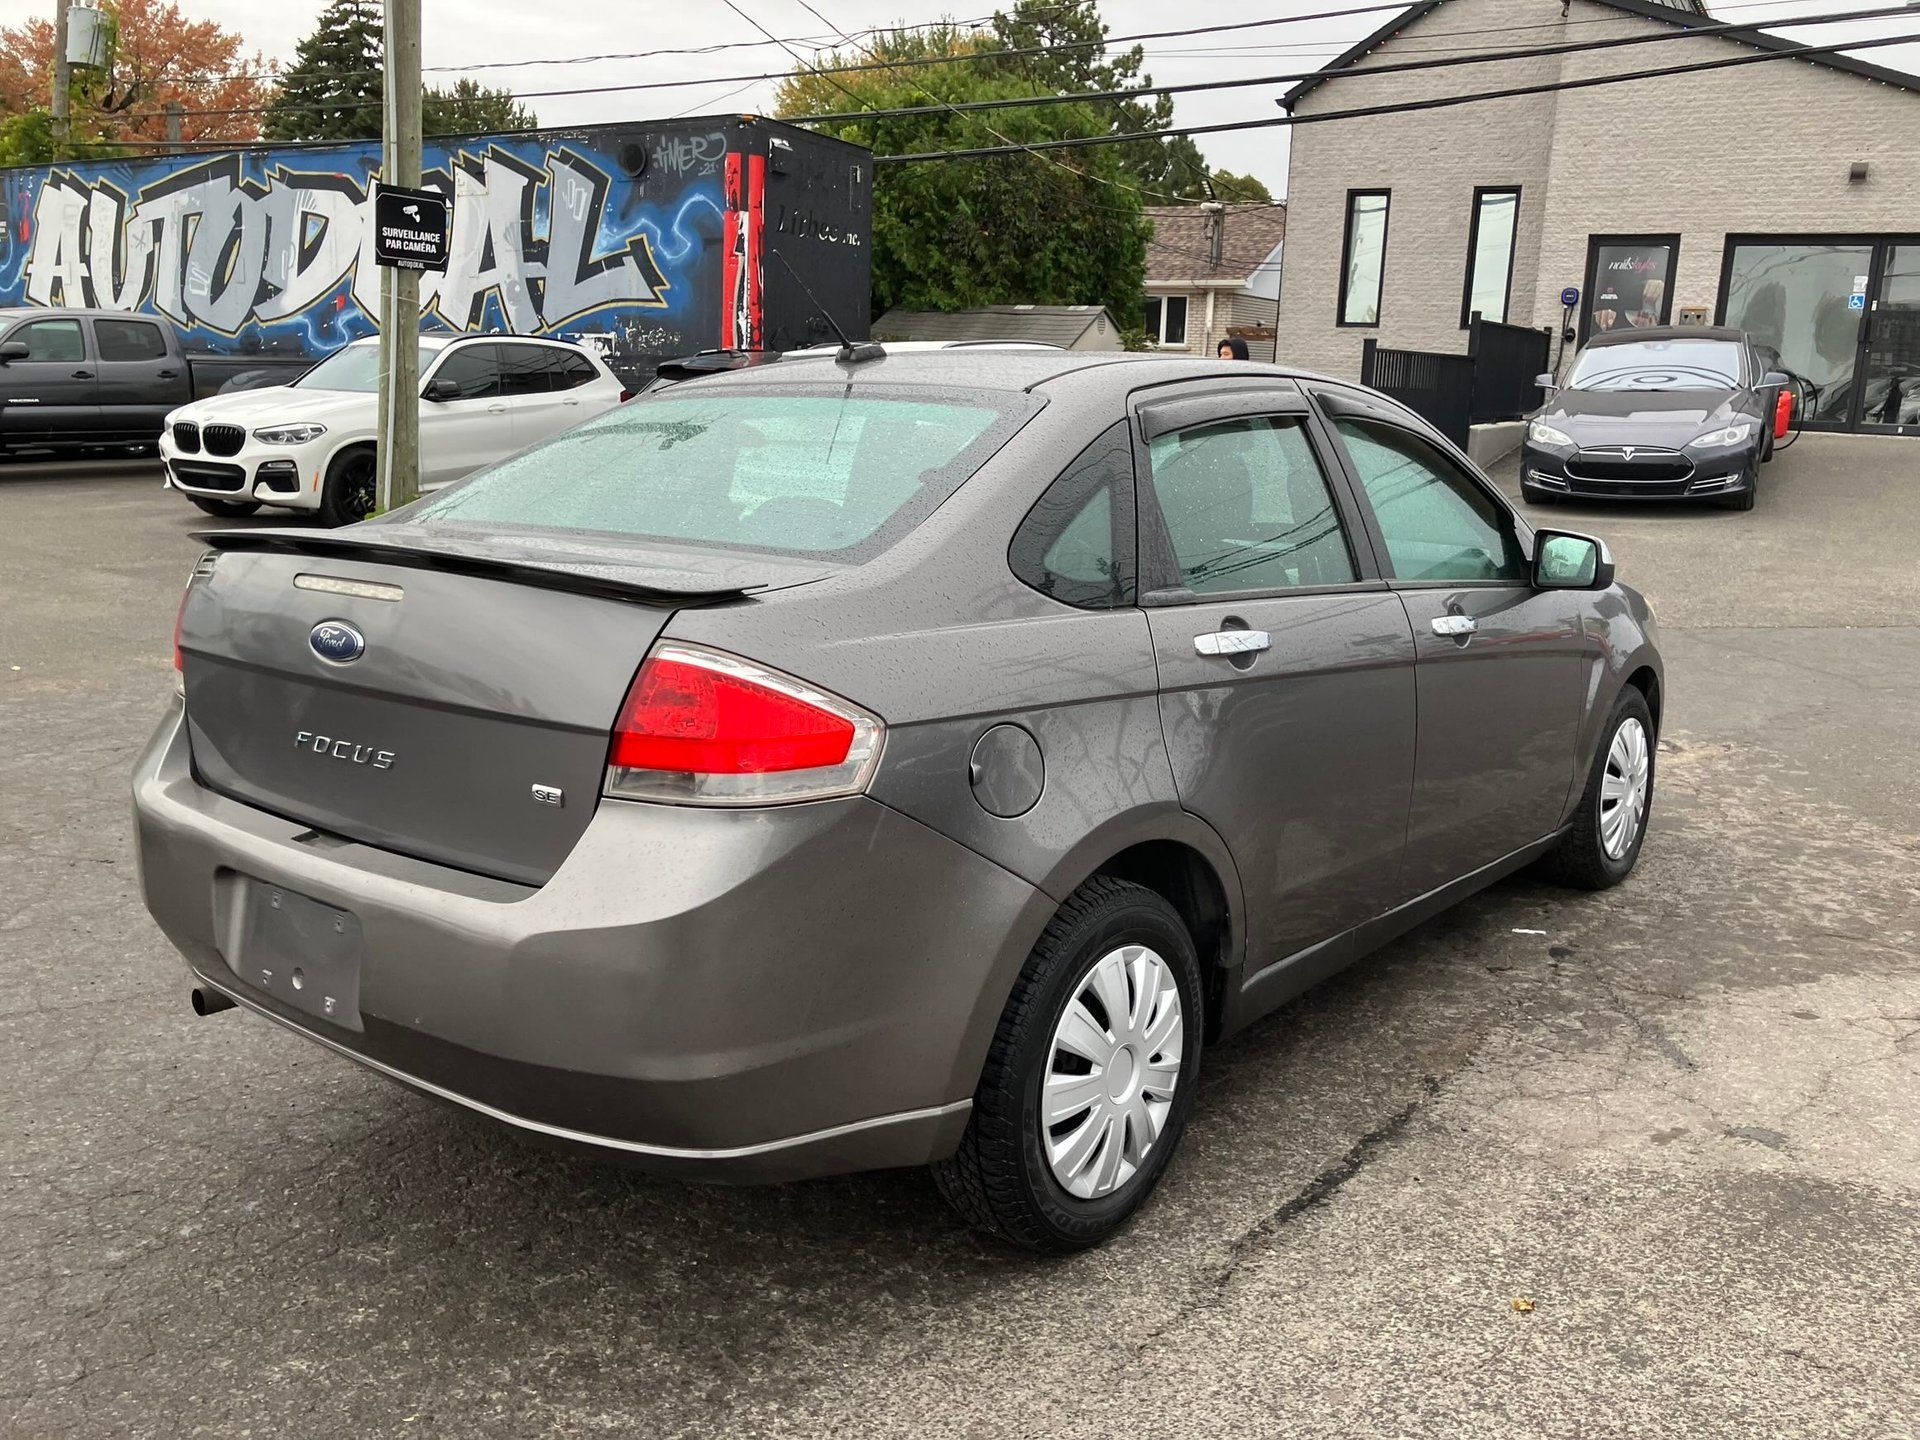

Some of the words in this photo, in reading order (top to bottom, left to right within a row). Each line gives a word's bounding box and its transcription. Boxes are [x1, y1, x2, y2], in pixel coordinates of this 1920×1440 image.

[382, 226, 441, 243] SURVEILLANCE
[385, 238, 402, 250] PAR
[403, 239, 437, 254] CAMÉRA
[318, 626, 347, 649] Ford
[295, 731, 396, 770] FOCUS
[534, 789, 558, 805] SE
